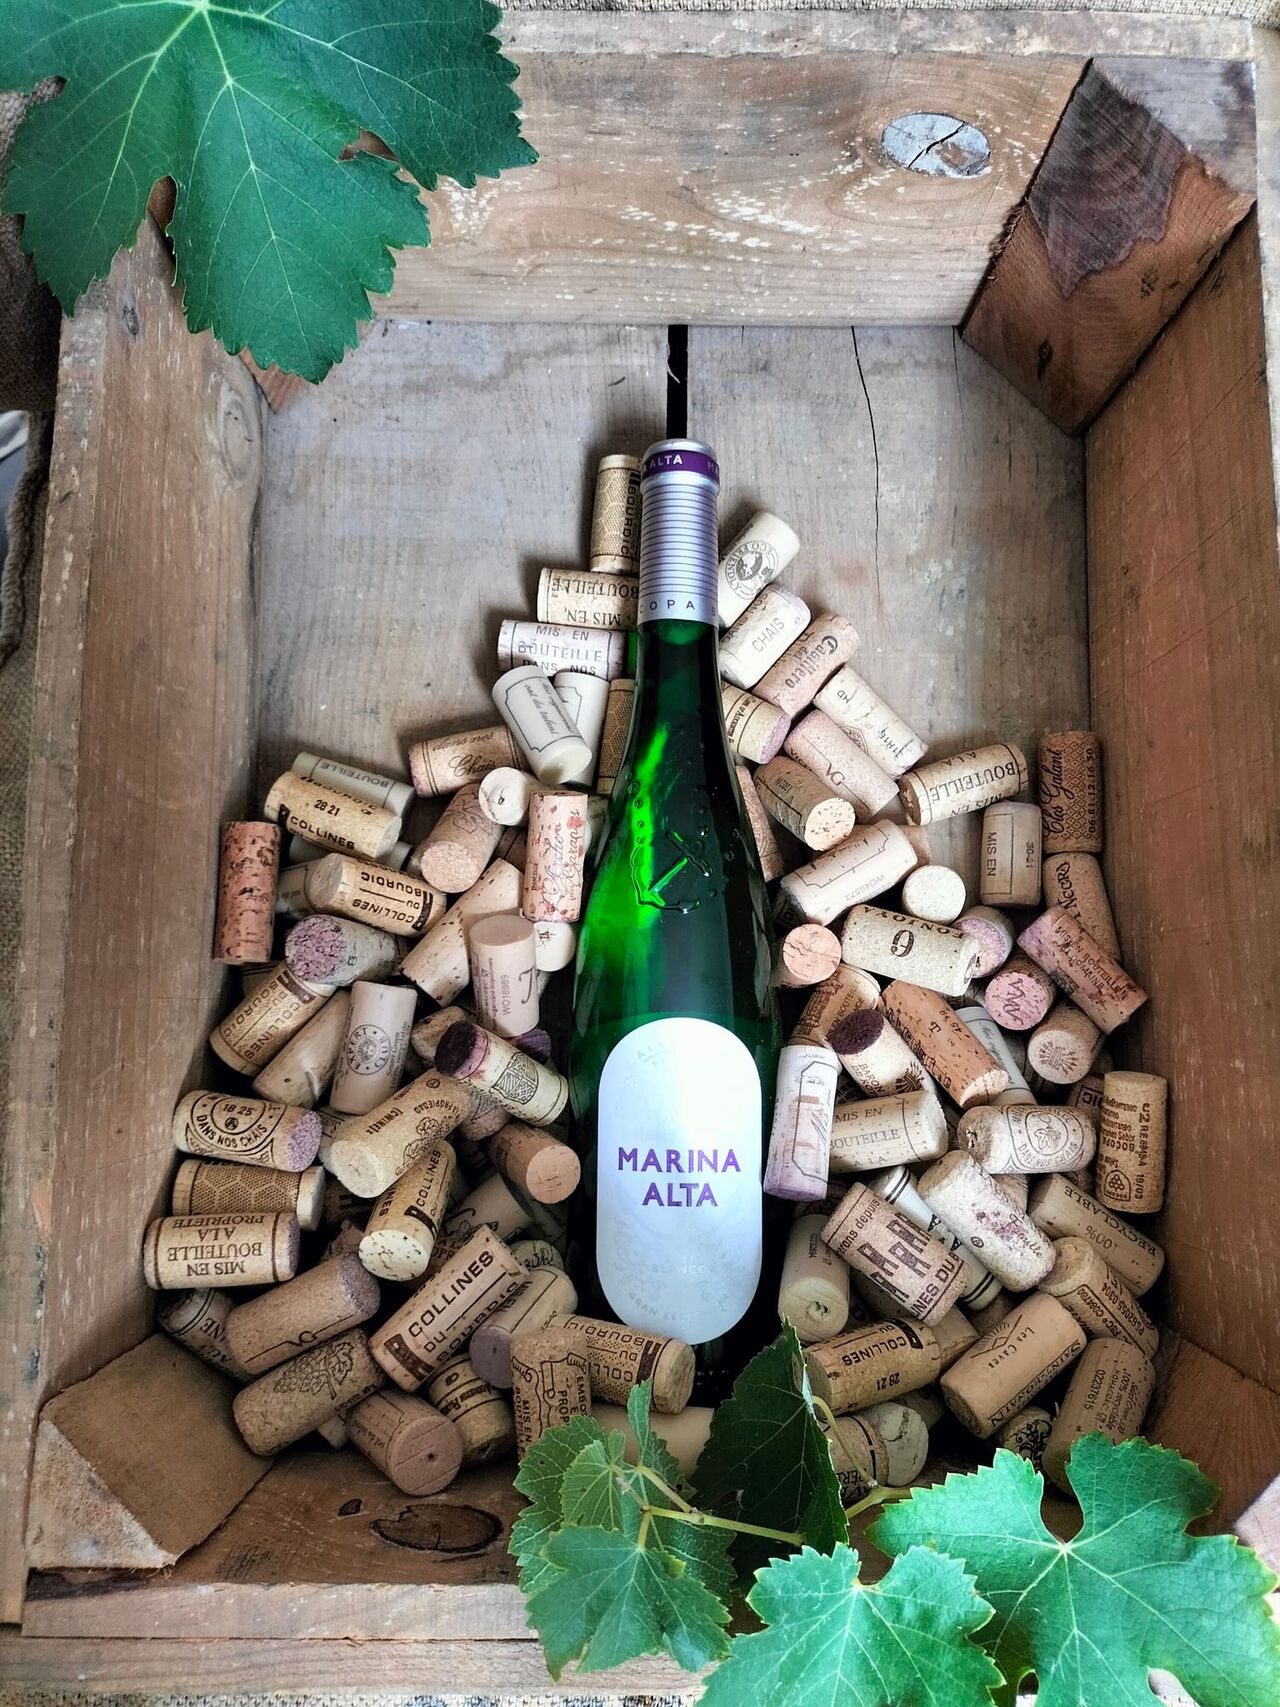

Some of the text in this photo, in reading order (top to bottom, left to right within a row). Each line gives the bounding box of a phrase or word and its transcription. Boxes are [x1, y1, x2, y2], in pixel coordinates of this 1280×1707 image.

[650, 454, 683, 469] ALTA
[620, 486, 637, 555] BOURDIC
[592, 609, 621, 624] MIS
[535, 625, 590, 641] MIS EN
[752, 617, 785, 652] CHAIS
[517, 640, 602, 662] BOUTEILLE
[785, 635, 838, 689] Casillero
[469, 732, 495, 744] nos
[319, 762, 390, 788] BOUTEILLE
[449, 753, 497, 777] Chais
[929, 761, 1016, 801] BOUTEILLE
[1041, 748, 1075, 841] Clos Galant
[1088, 748, 1097, 833] 06.81.12.16.50
[314, 799, 341, 816] 28 21
[290, 815, 355, 850] COLLINES
[987, 832, 997, 876] MIS EN
[361, 871, 422, 898] BOURDIC
[1055, 861, 1078, 911] NEGRA
[352, 897, 415, 924] COLLINES
[406, 899, 420, 910] DU
[863, 906, 965, 940] FONJOYA
[222, 981, 278, 1038] BOURDIC
[271, 990, 288, 1009] DU
[831, 1017, 841, 1028] EN
[836, 979, 861, 1018] BOUTEILLE
[244, 1001, 301, 1059] COLLINES
[374, 1036, 389, 1068] CLUB
[858, 1063, 886, 1094] BARON
[223, 1103, 255, 1116] 18 25
[835, 1106, 883, 1122] MIS EN
[196, 1114, 268, 1148] DANS NOS CHAIS
[829, 1128, 902, 1150] BOUTEILLE
[618, 1147, 741, 1173] MARINA
[1018, 1143, 1036, 1165] DANS
[1036, 1156, 1052, 1168] NOS
[1053, 1141, 1079, 1166] CHAIS
[416, 1150, 442, 1207] COLLINES
[642, 1182, 718, 1207] ALTA
[172, 1215, 265, 1229] PROPRIETE
[855, 1197, 881, 1230] depuis
[1065, 1185, 1158, 1257] RECYCLABLE
[167, 1242, 264, 1262] BOUTEILLE
[186, 1260, 245, 1276] MIS EN
[935, 1257, 955, 1283] DU
[408, 1250, 494, 1338] COLLINES
[437, 1281, 521, 1362] BOURDIC
[567, 1321, 644, 1347] BOURDIC
[879, 1325, 895, 1334] DU
[424, 1332, 447, 1353] DU
[619, 1351, 637, 1361] DU
[842, 1336, 907, 1366] COLLINES
[988, 1326, 1035, 1369] Les Caves
[876, 1372, 901, 1391] 28 21
[1083, 1368, 1106, 1410] 02237615
[522, 1399, 532, 1443] MIS EN
[1106, 1392, 1123, 1430] recyclable
